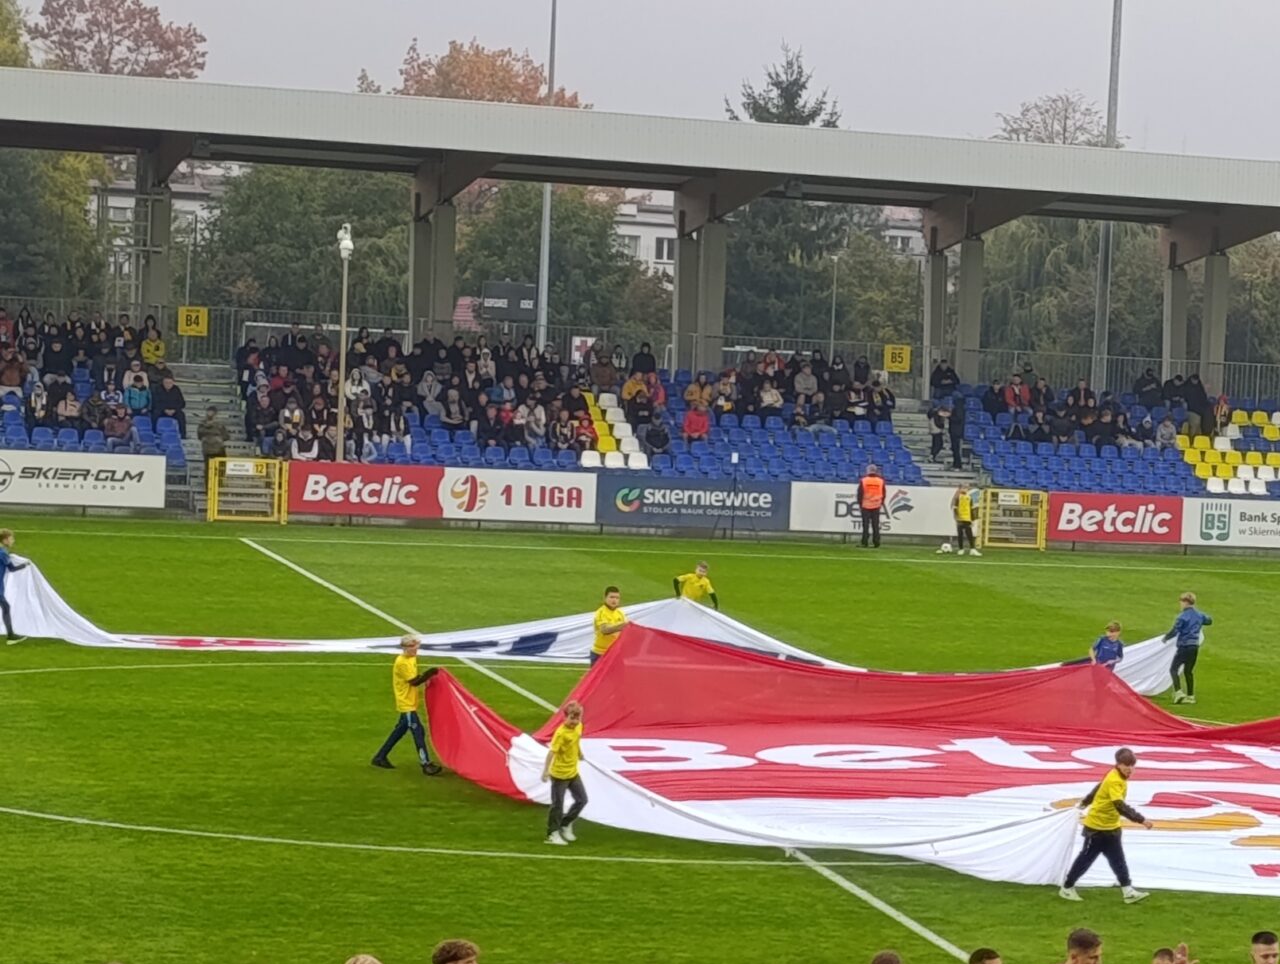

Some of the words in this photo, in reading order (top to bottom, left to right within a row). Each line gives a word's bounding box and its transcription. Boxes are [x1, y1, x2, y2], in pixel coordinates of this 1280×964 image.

[186, 314, 200, 327] B4
[303, 474, 419, 506] Betclic
[501, 484, 513, 506] 1
[524, 485, 582, 509] LIGA
[834, 500, 890, 520] DEA
[1057, 502, 1172, 535] Betclic
[1239, 511, 1268, 523] Bank
